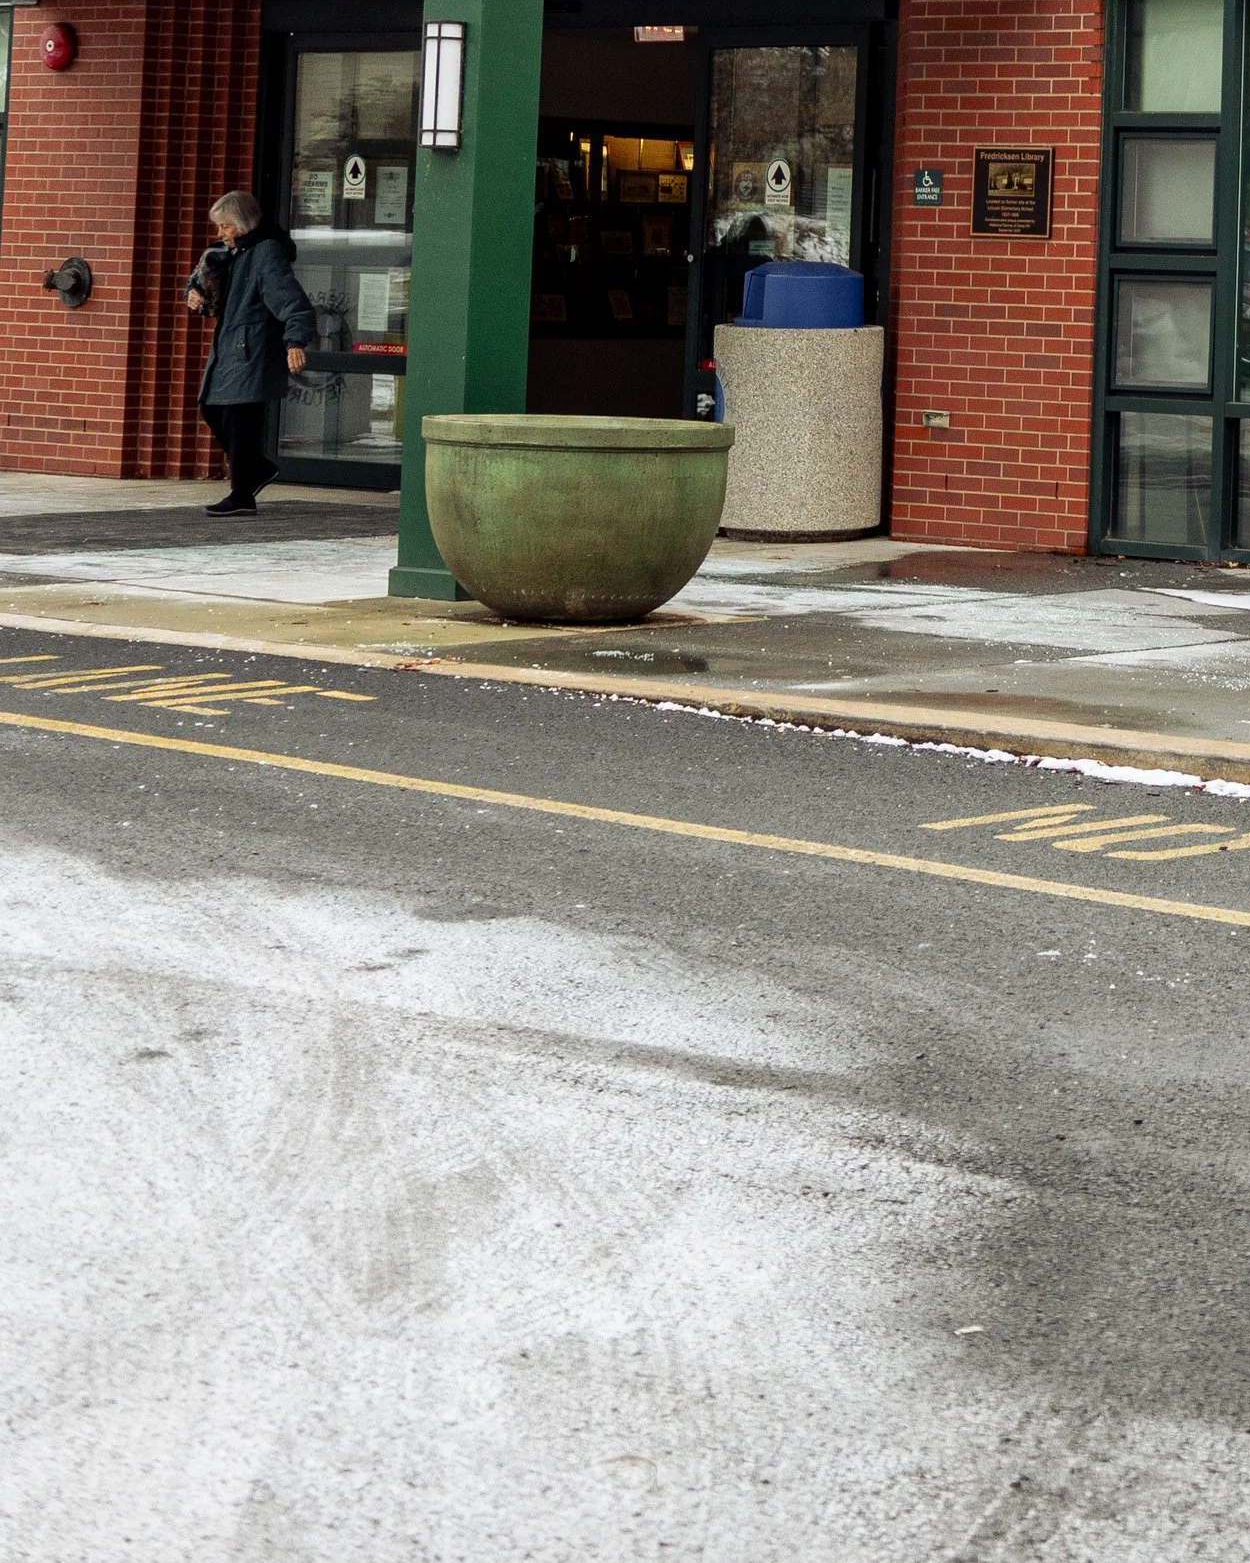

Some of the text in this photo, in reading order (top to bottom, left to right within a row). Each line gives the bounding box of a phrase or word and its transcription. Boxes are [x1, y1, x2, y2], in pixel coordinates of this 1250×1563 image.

[981, 151, 1045, 163] Fredricksen Library
[359, 344, 404, 353] AUTOMATIC DOOR
